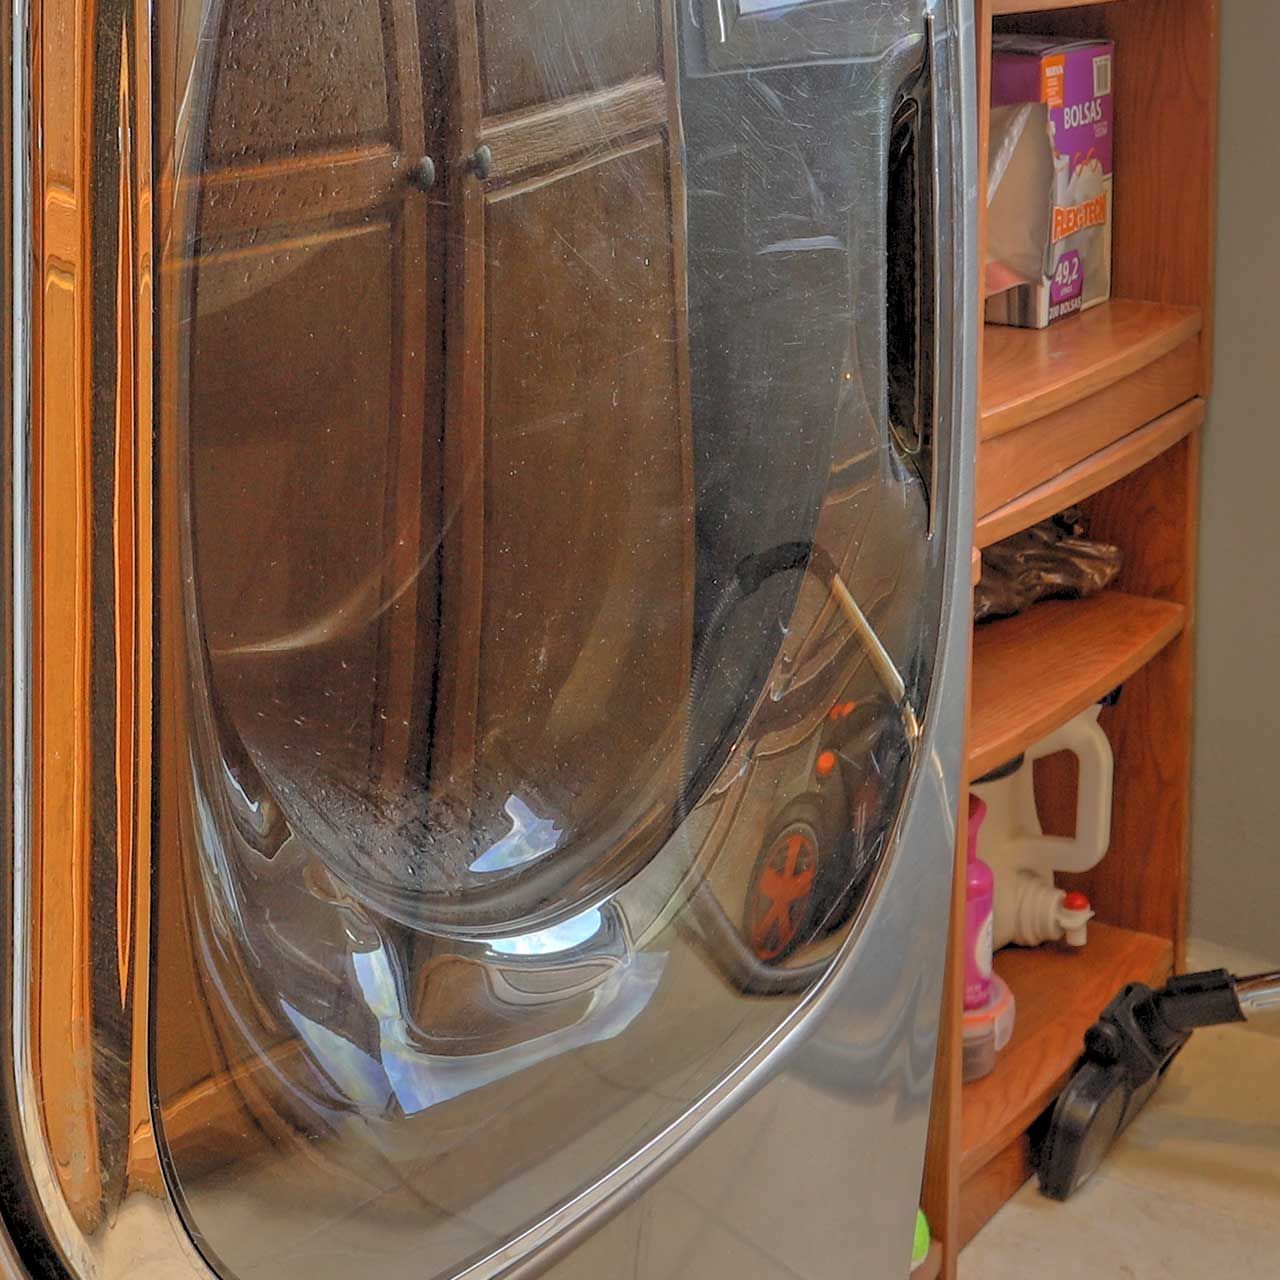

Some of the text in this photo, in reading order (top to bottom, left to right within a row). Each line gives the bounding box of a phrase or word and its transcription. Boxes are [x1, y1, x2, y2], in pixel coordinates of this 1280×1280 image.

[1063, 99, 1102, 130] BOLSAS
[1054, 257, 1079, 286] 49,2
[1059, 295, 1082, 317] BOLSAS
